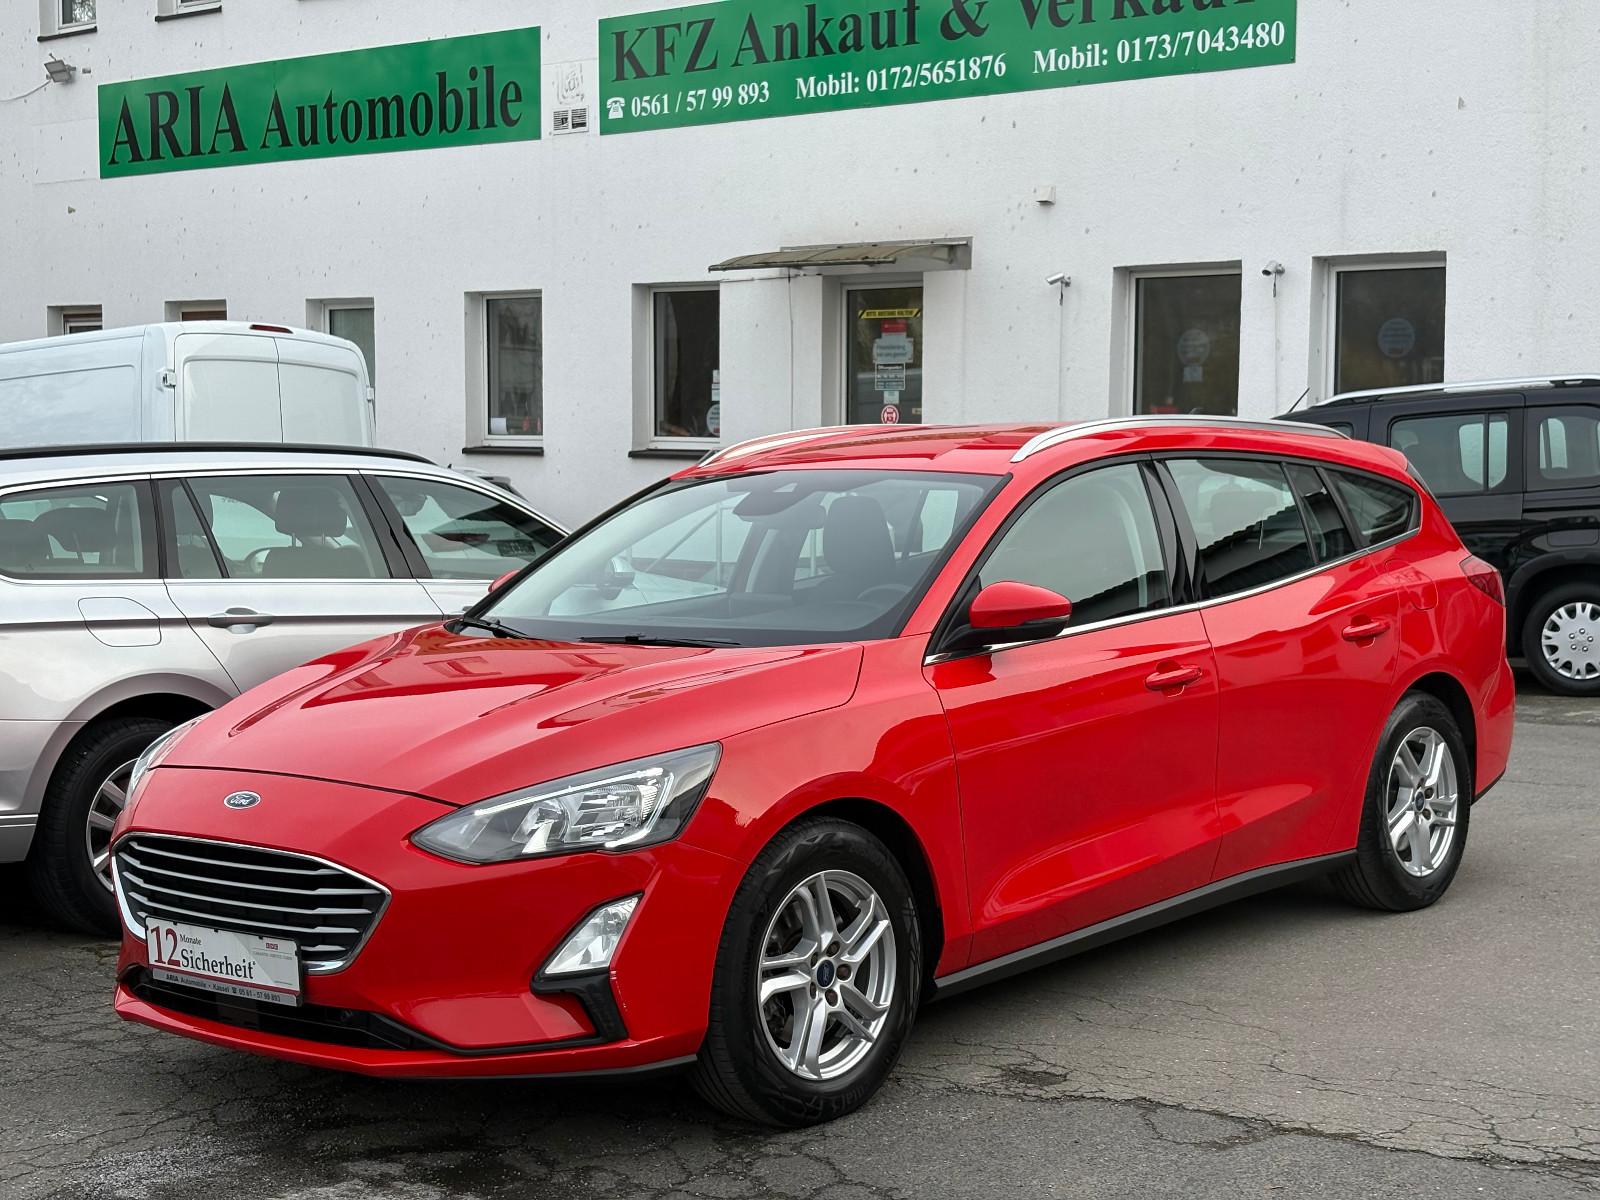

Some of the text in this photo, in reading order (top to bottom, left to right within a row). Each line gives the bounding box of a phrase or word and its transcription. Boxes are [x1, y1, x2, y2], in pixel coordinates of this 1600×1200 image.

[611, 18, 719, 82] KFZ
[731, 0, 920, 67] Ankauf
[940, 0, 989, 40] &
[631, 21, 1285, 117] 0561 / 57 99 893 Mobil: 0172/5651876 Mobil: 0173/7043480
[107, 65, 523, 166] ARIA Automobile
[150, 925, 181, 967] 12
[179, 934, 202, 946] Monate
